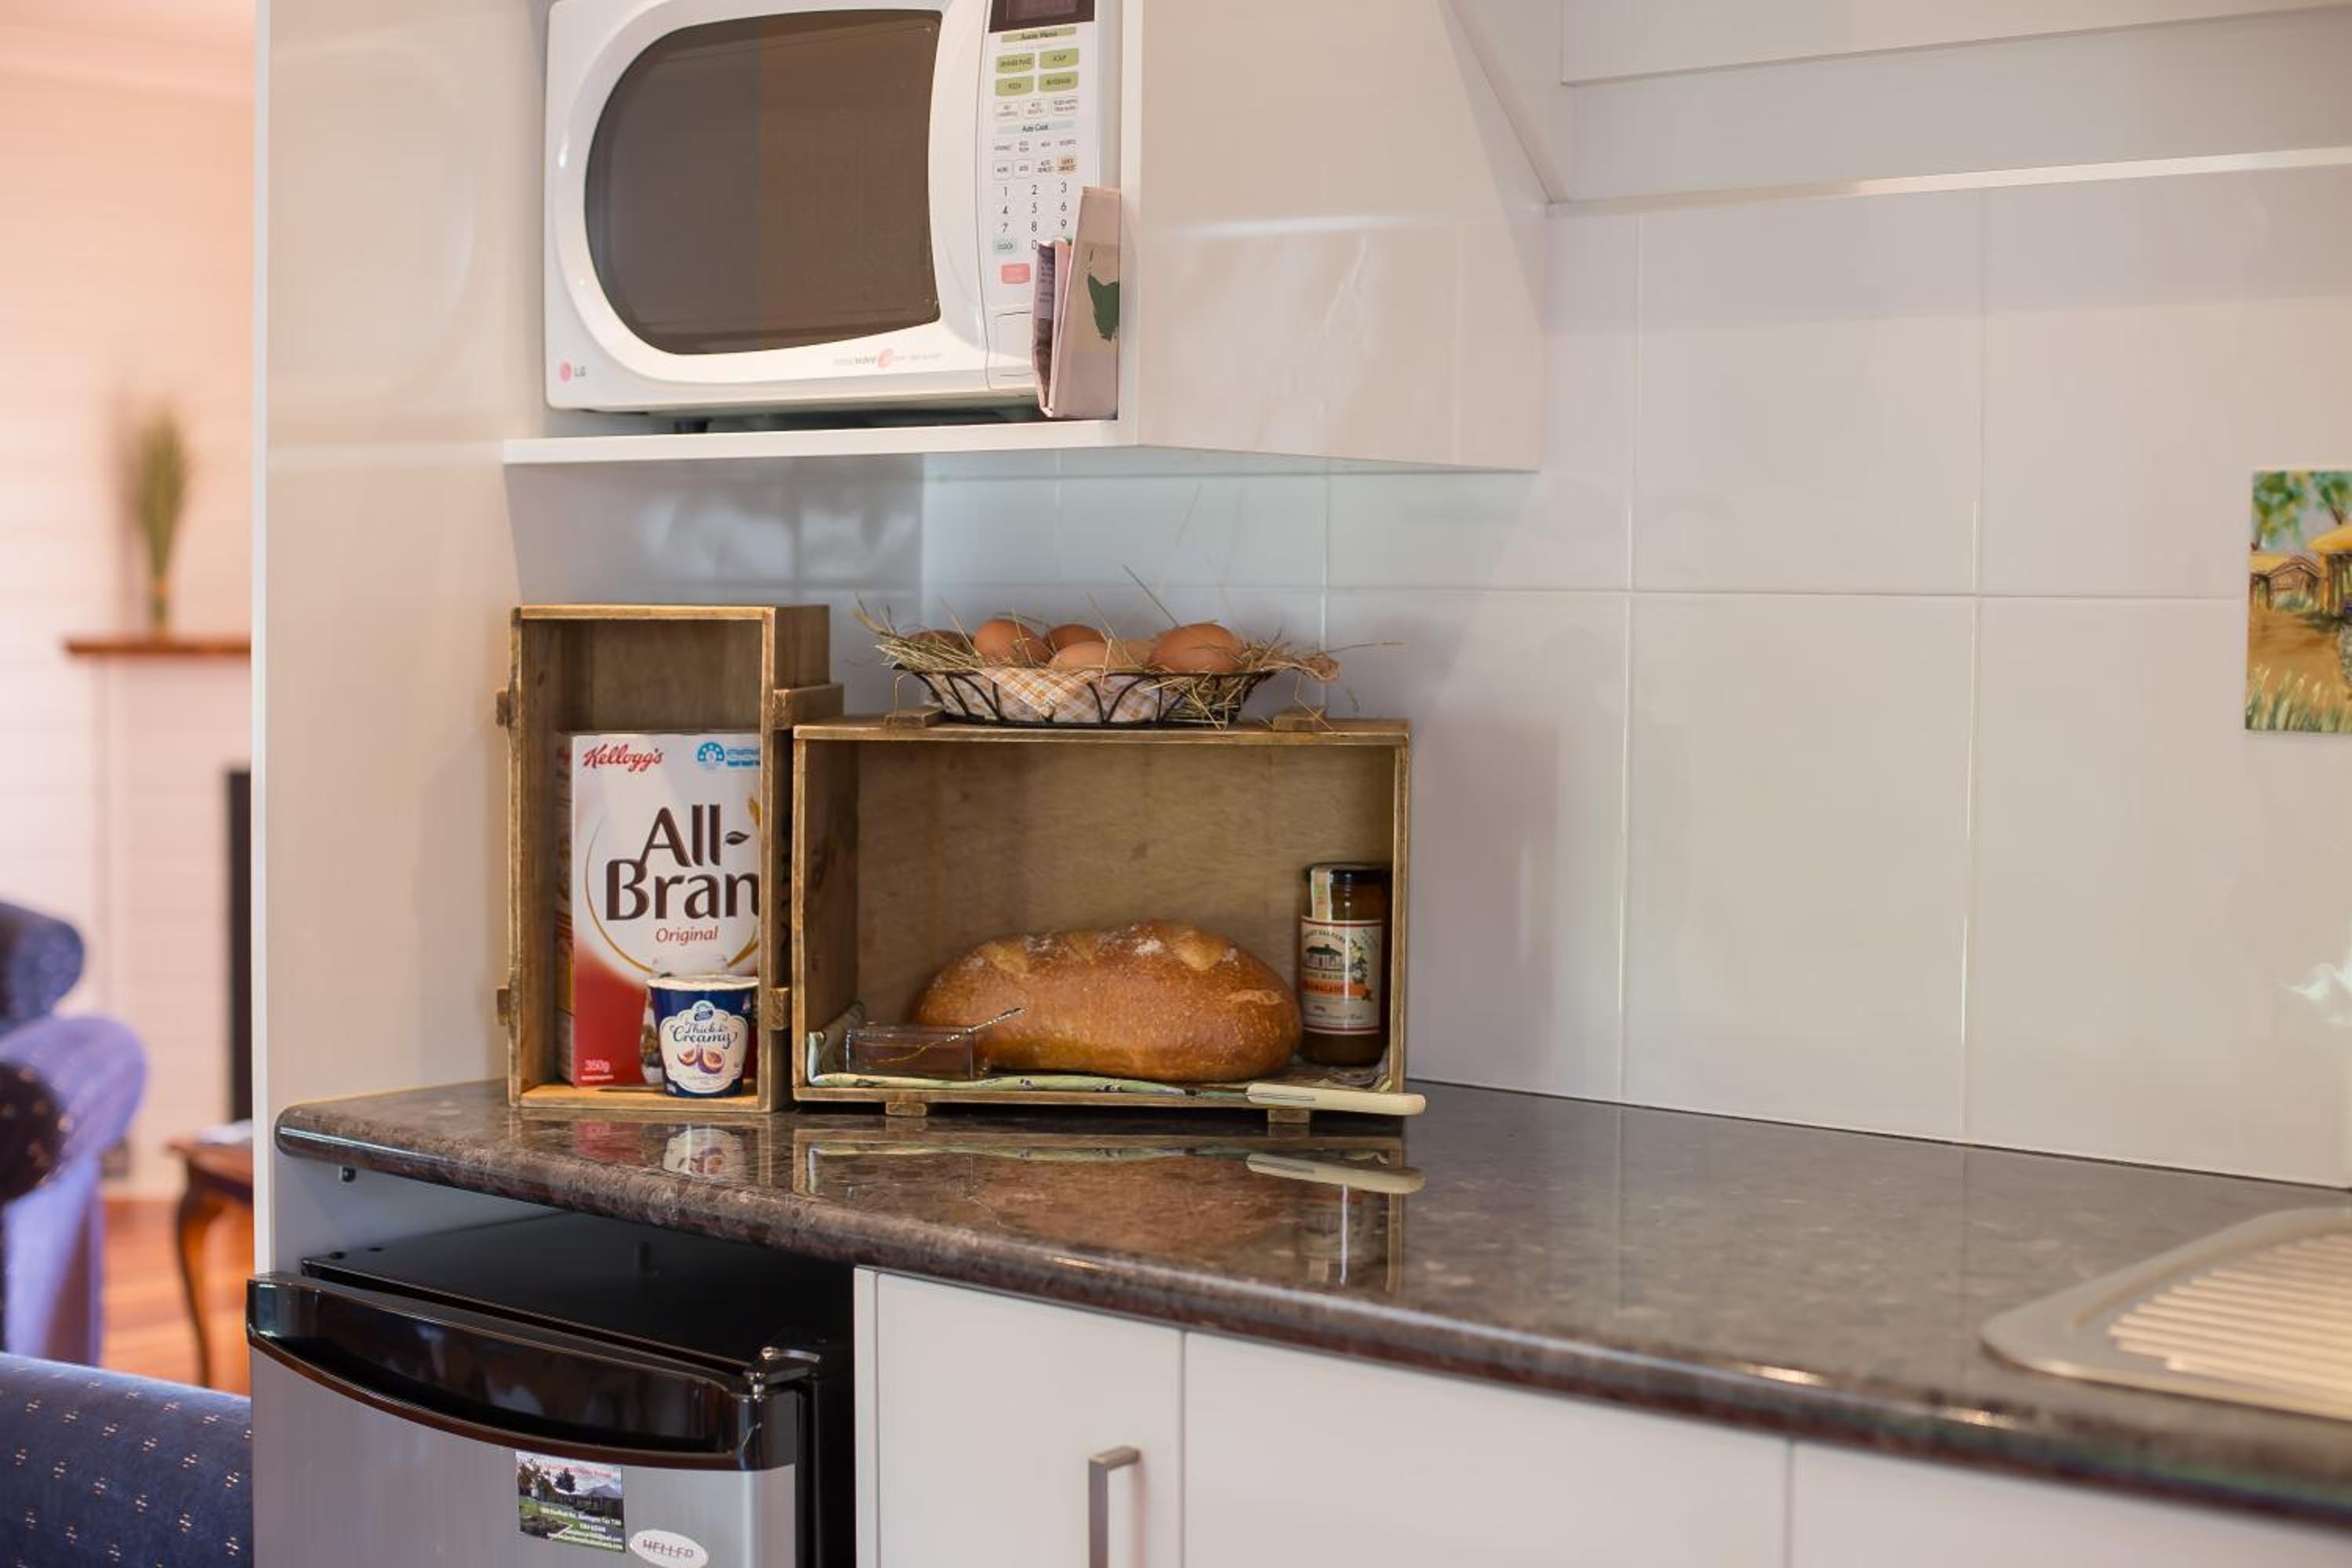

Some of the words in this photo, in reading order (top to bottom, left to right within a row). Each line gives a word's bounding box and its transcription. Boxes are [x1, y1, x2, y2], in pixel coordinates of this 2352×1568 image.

[1031, 184, 1038, 195] 2
[1061, 181, 1067, 193] 3
[1002, 205, 1008, 215] 4
[1032, 201, 1037, 214] 5
[1061, 201, 1067, 212] 6
[1002, 223, 1008, 233] 7
[1031, 221, 1037, 232] 8
[1061, 219, 1067, 230] 9
[1031, 239, 1037, 250] 0
[583, 743, 664, 772] Kellogg's
[605, 858, 759, 921] Bran
[655, 926, 719, 946] Original
[670, 1025, 737, 1050] Creamy
